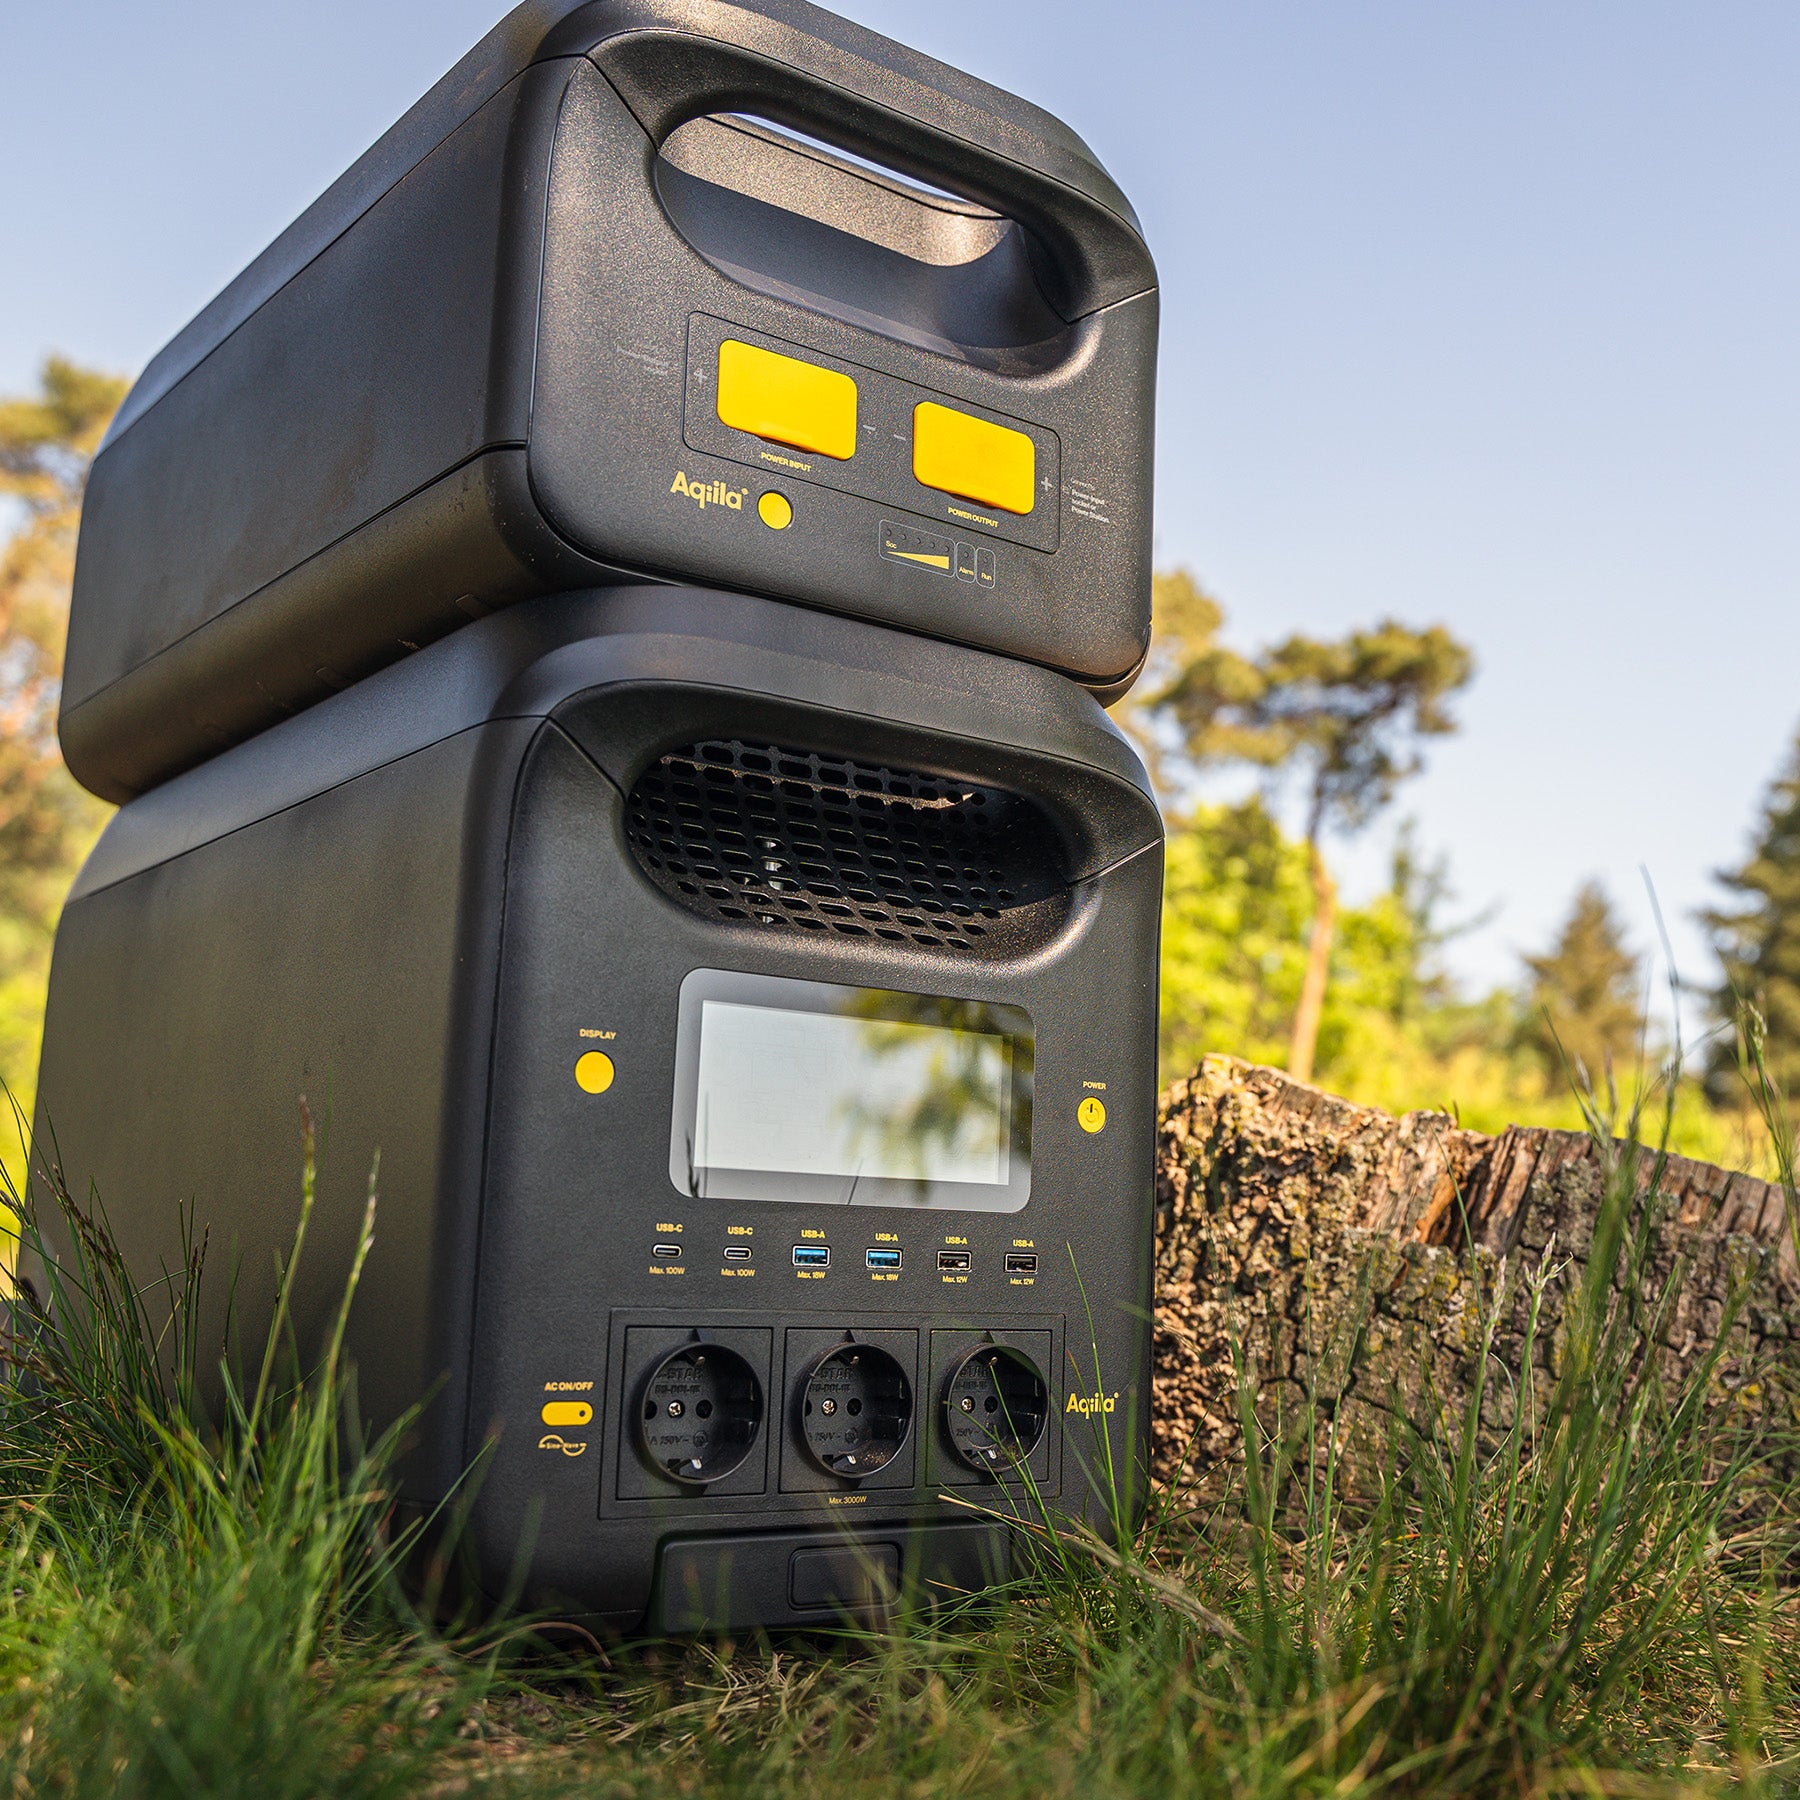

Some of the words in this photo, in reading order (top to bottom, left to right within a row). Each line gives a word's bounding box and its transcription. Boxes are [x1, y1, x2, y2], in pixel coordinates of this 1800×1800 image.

[761, 452, 789, 466] POWER
[789, 459, 812, 472] INPUT
[670, 471, 743, 510] Aqiila
[948, 506, 973, 520] POWER
[972, 514, 999, 528] OUTPUT
[959, 566, 975, 576] Alarm
[981, 572, 993, 581] Run
[579, 1028, 617, 1041] DISPLAY
[1082, 1080, 1107, 1090] POWER
[656, 1223, 683, 1233] USB-C
[727, 1226, 753, 1236] USB-C
[801, 1229, 826, 1239] USB-A
[875, 1233, 899, 1242] USB-A
[945, 1236, 968, 1245] USB-A
[1013, 1239, 1035, 1248] USB-A
[649, 1266, 664, 1275] Max.
[665, 1266, 685, 1275] 100W
[721, 1268, 736, 1277] Max.
[736, 1268, 756, 1277] 100W
[812, 1271, 826, 1280] 18W
[955, 1276, 968, 1284] 12W
[1023, 1278, 1035, 1286] 12W
[544, 1381, 558, 1391] AC
[558, 1381, 594, 1391] ON/OFF
[1065, 1392, 1115, 1420] Aqiila
[843, 1495, 867, 1504] 3000W
